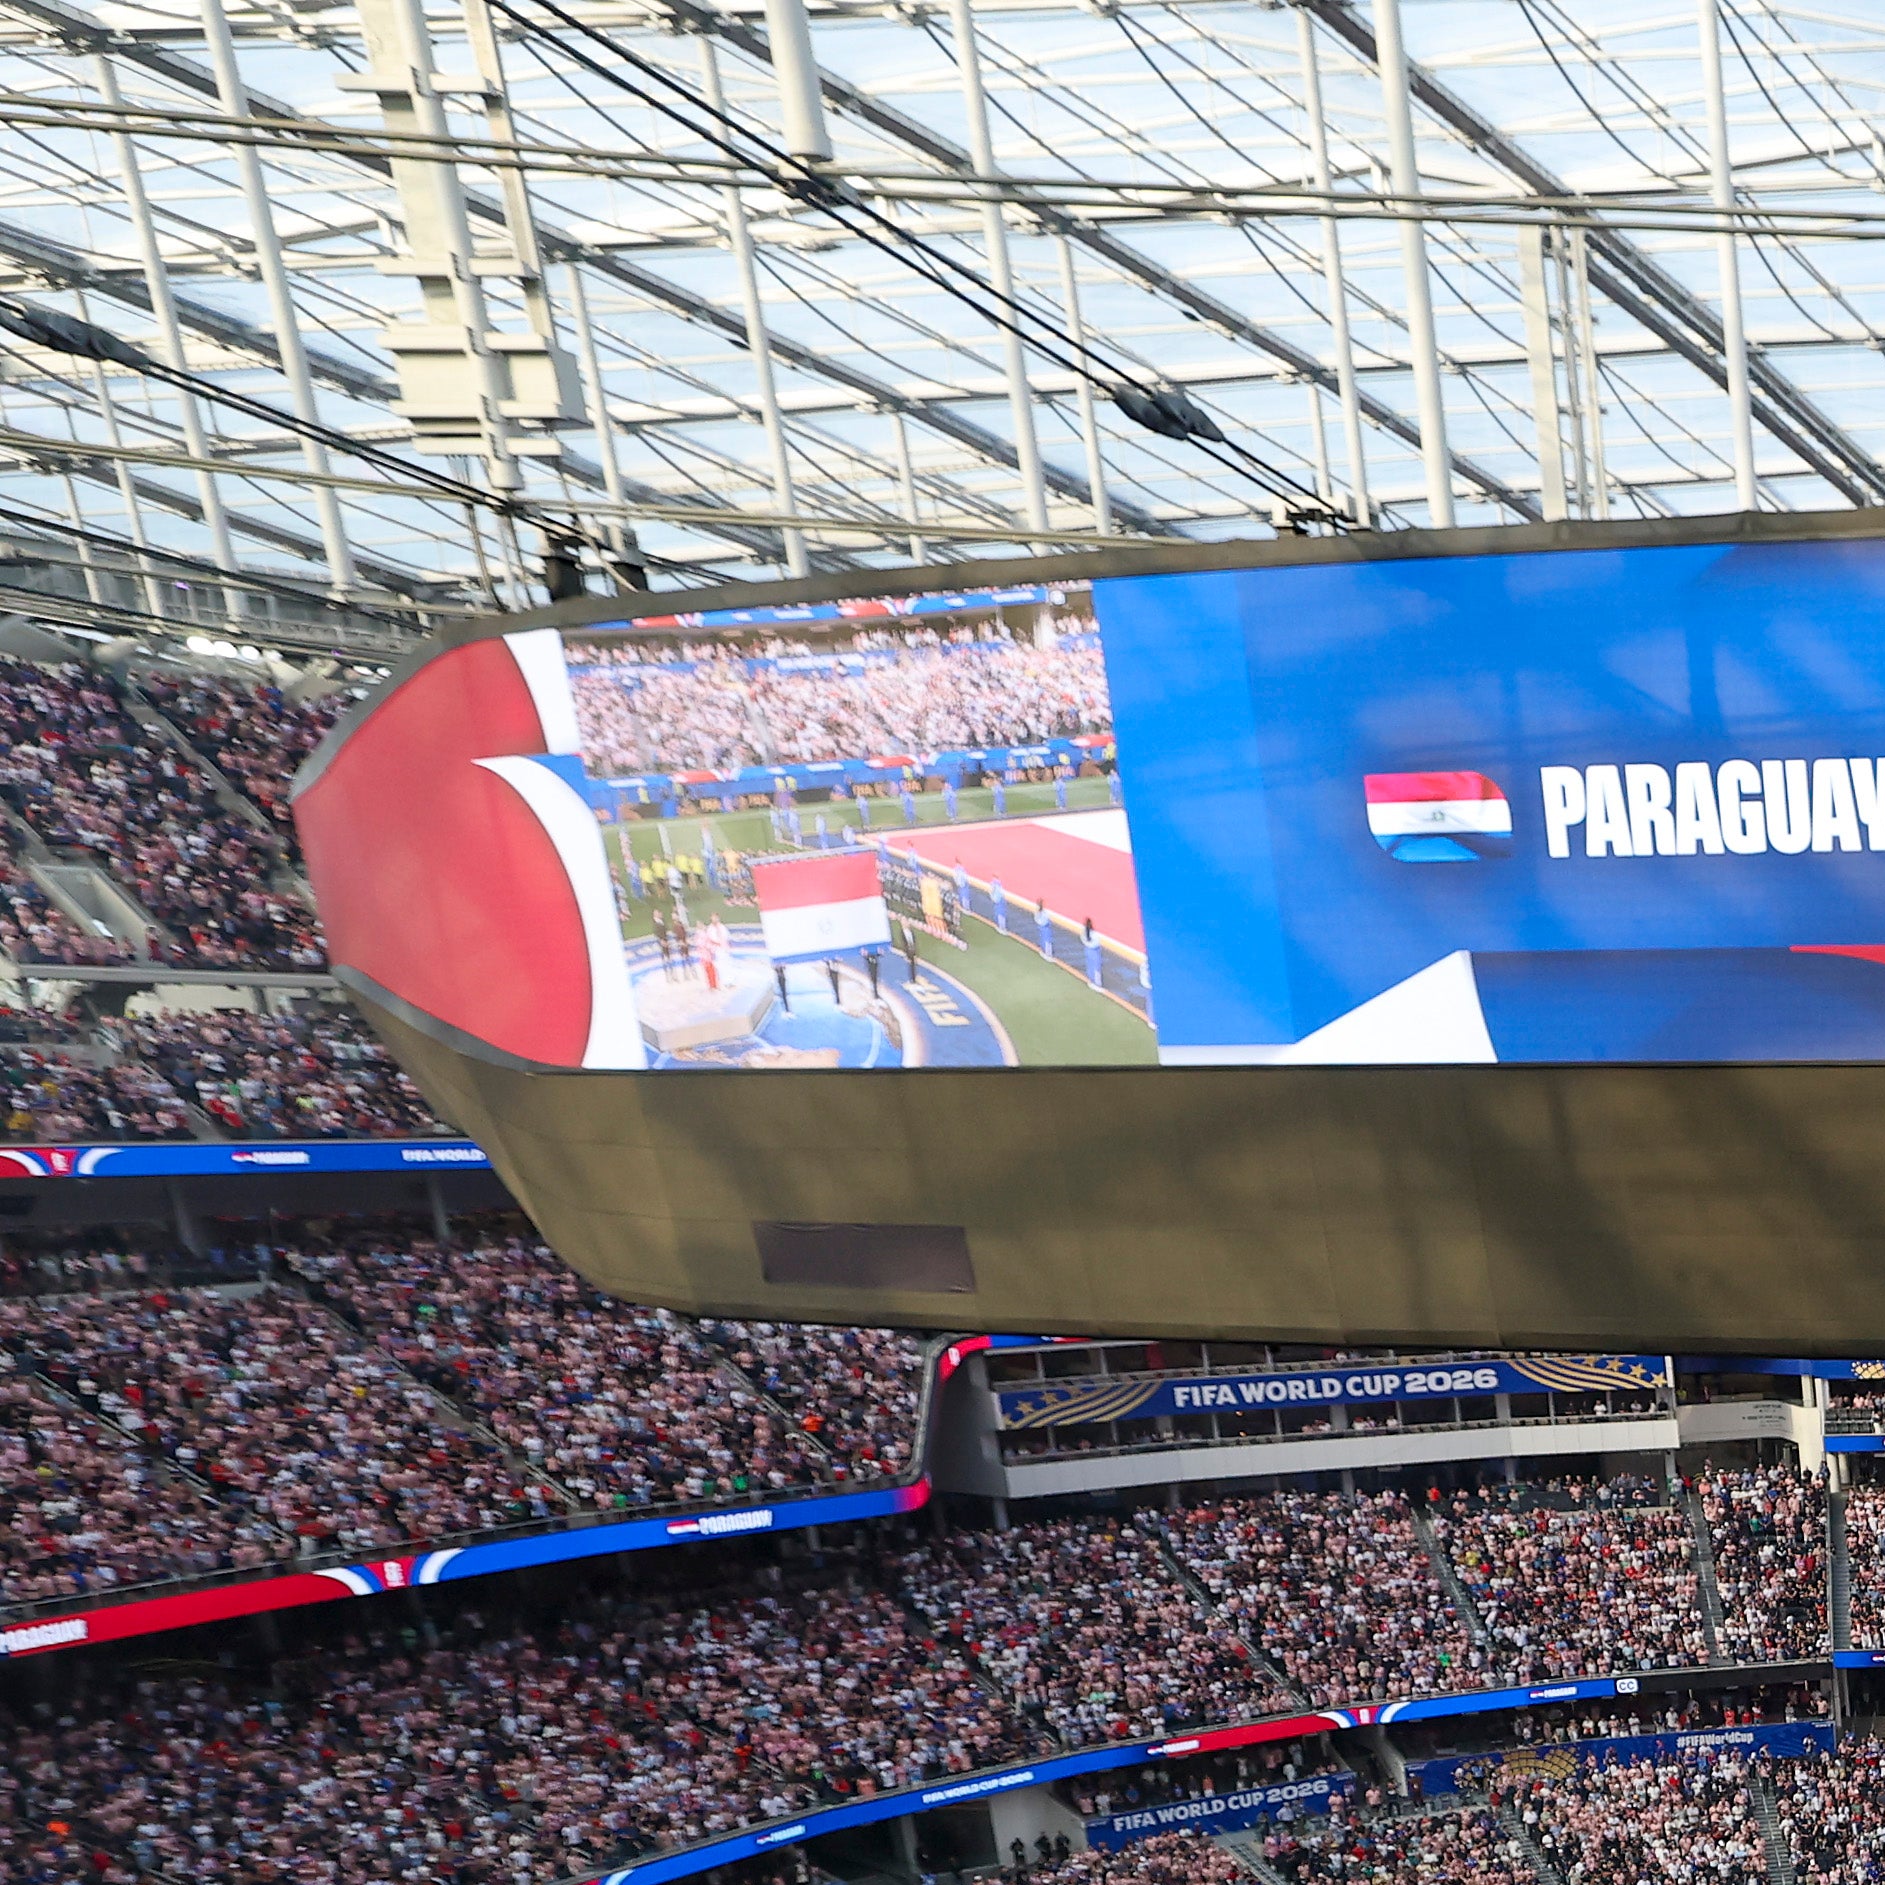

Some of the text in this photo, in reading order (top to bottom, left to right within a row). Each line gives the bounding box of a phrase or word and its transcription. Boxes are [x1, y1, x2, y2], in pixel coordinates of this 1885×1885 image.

[1174, 1369, 1499, 1408] FIFA WORLD CUP 2026
[698, 1509, 773, 1536] PARAGUAY
[1619, 1681, 1636, 1691] CC
[1676, 1731, 1754, 1748] #FIFAWorldCup
[1113, 1779, 1330, 1832] FIFA WORLD CUP 2026
